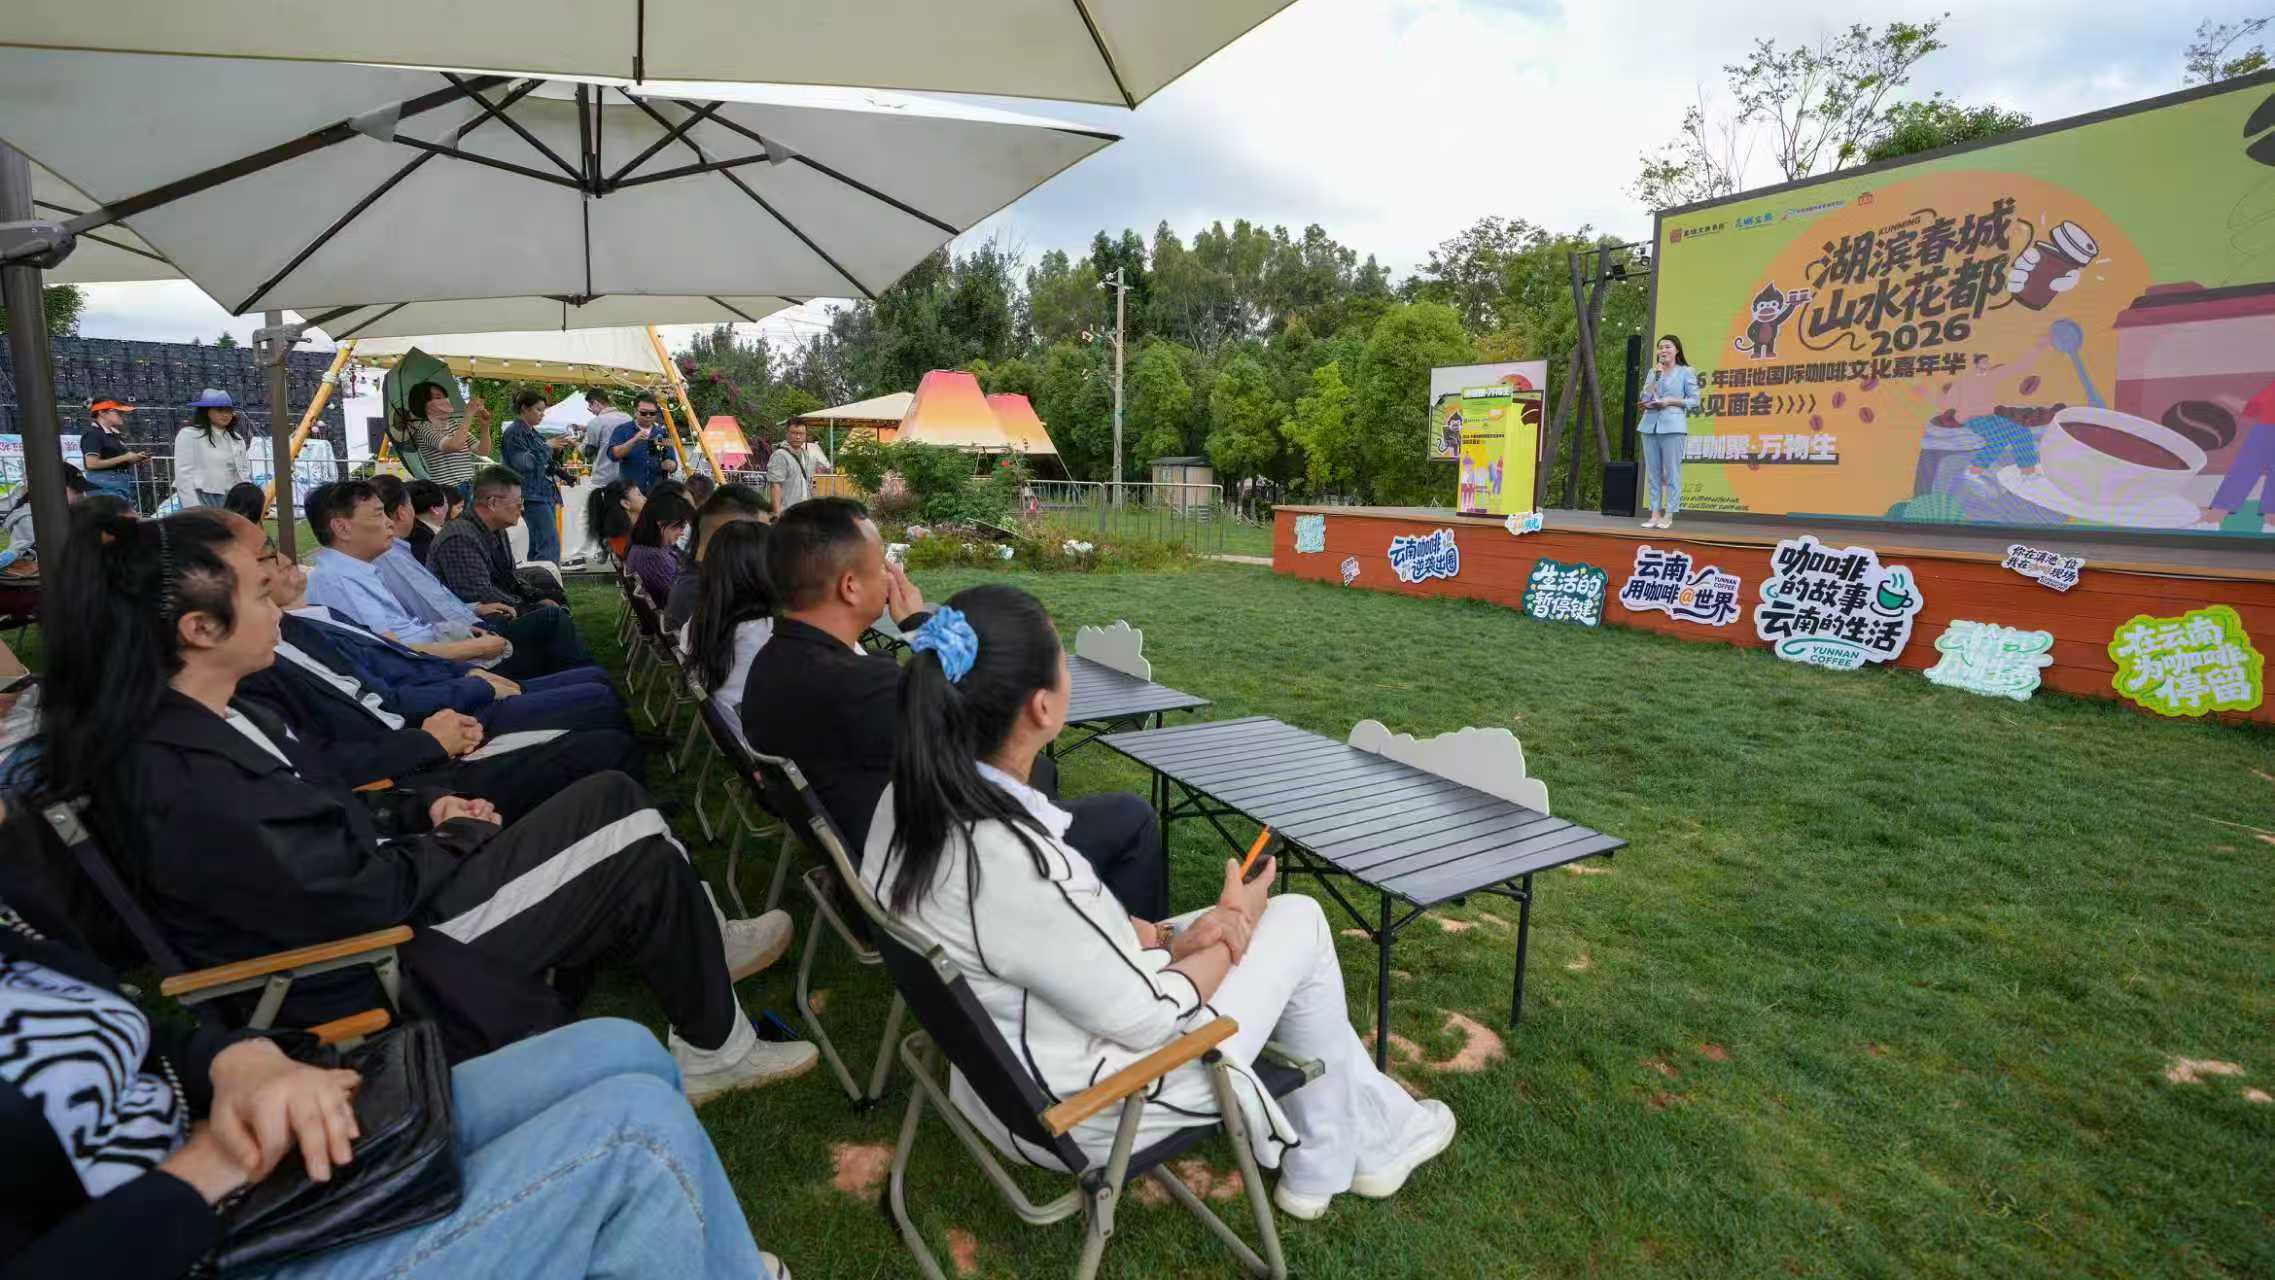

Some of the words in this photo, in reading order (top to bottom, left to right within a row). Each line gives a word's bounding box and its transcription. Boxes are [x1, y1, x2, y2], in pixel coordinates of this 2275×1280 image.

[1813, 197, 2016, 288] 湖滨春城
[1879, 216, 1921, 235] KUNMING
[1808, 253, 2010, 337] 山水花都
[1870, 313, 1971, 356] 2026
[1389, 533, 1441, 567] 云南咖啡
[1638, 553, 1688, 581] 云南
[1778, 543, 1870, 582] 咖啡
[1532, 564, 1601, 598] 生活的
[1714, 576, 1737, 586] YUNNAN
[1779, 575, 1872, 616] 的故事
[1533, 591, 1597, 626] 暂停键
[1760, 600, 1904, 652] 云南的生活
[1812, 646, 1860, 659] YUNNAN
[2118, 616, 2223, 657] 在云南
[1810, 654, 1852, 667] COFFEE
[2128, 643, 2249, 691] 为咖啡
[2155, 666, 2251, 707] 停留
